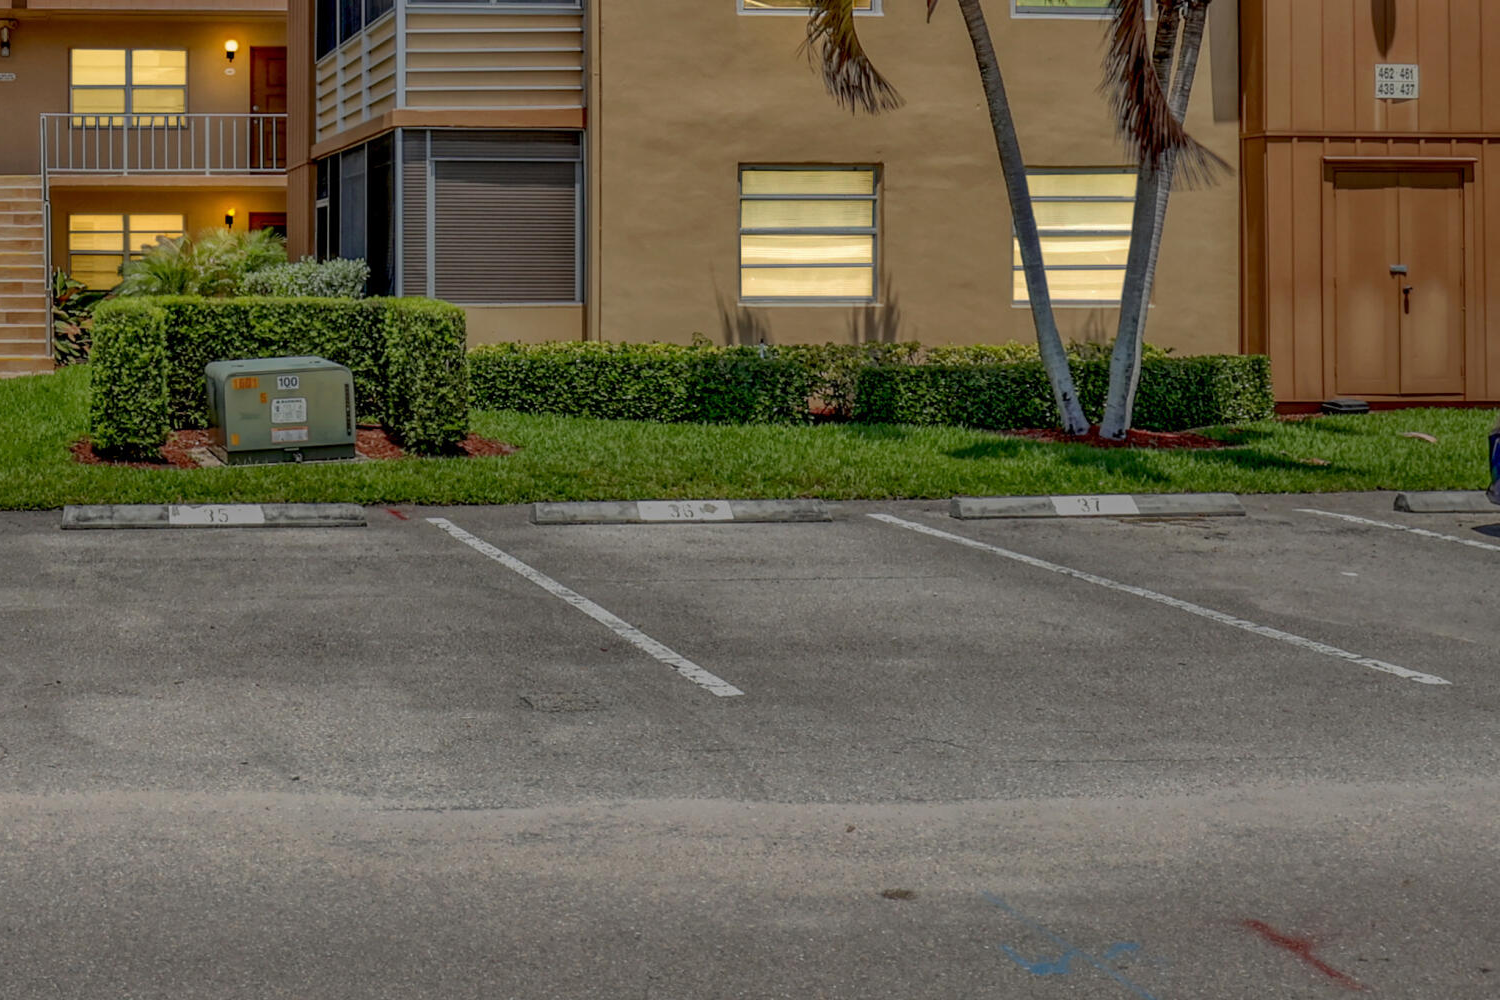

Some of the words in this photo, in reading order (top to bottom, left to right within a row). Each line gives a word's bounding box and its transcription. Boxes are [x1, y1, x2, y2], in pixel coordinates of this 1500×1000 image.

[1378, 83, 1395, 95] 438
[1400, 83, 1415, 95] 437
[278, 376, 298, 388] 100
[668, 503, 694, 518] 36
[1077, 497, 1100, 512] 37
[204, 508, 229, 522] 35
